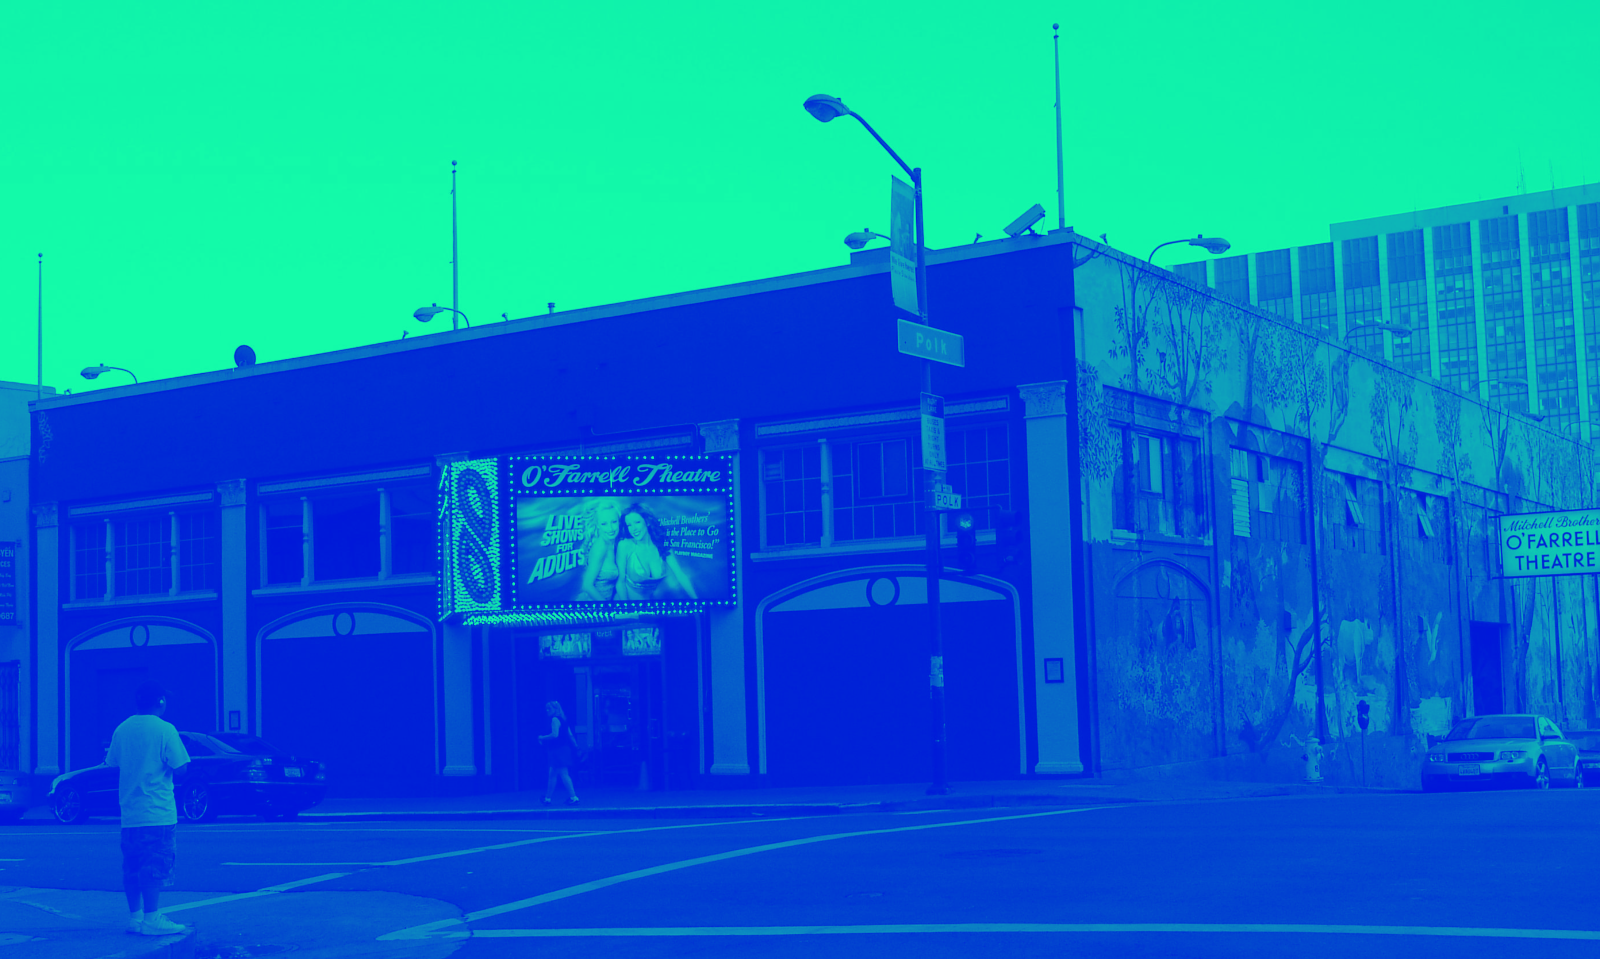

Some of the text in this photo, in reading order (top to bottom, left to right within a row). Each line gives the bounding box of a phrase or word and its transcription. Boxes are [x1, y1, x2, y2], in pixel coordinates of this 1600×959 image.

[916, 332, 947, 355] Polk
[521, 463, 721, 488] O'Farrell Theatre
[937, 494, 959, 507] POLK
[545, 514, 583, 531] LIVE
[1503, 516, 1555, 532] Mitchell
[540, 529, 584, 547] SHOWS
[666, 525, 719, 537] is the Place to Go
[556, 543, 574, 553] FOR
[663, 539, 669, 547] in
[670, 538, 680, 547] San
[1506, 530, 1600, 550] O'FARRELL
[691, 551, 714, 559] MAGAZINE
[1515, 551, 1595, 570] THEATRE
[527, 548, 585, 585] ADULTS
[0, 612, 14, 620] 687
